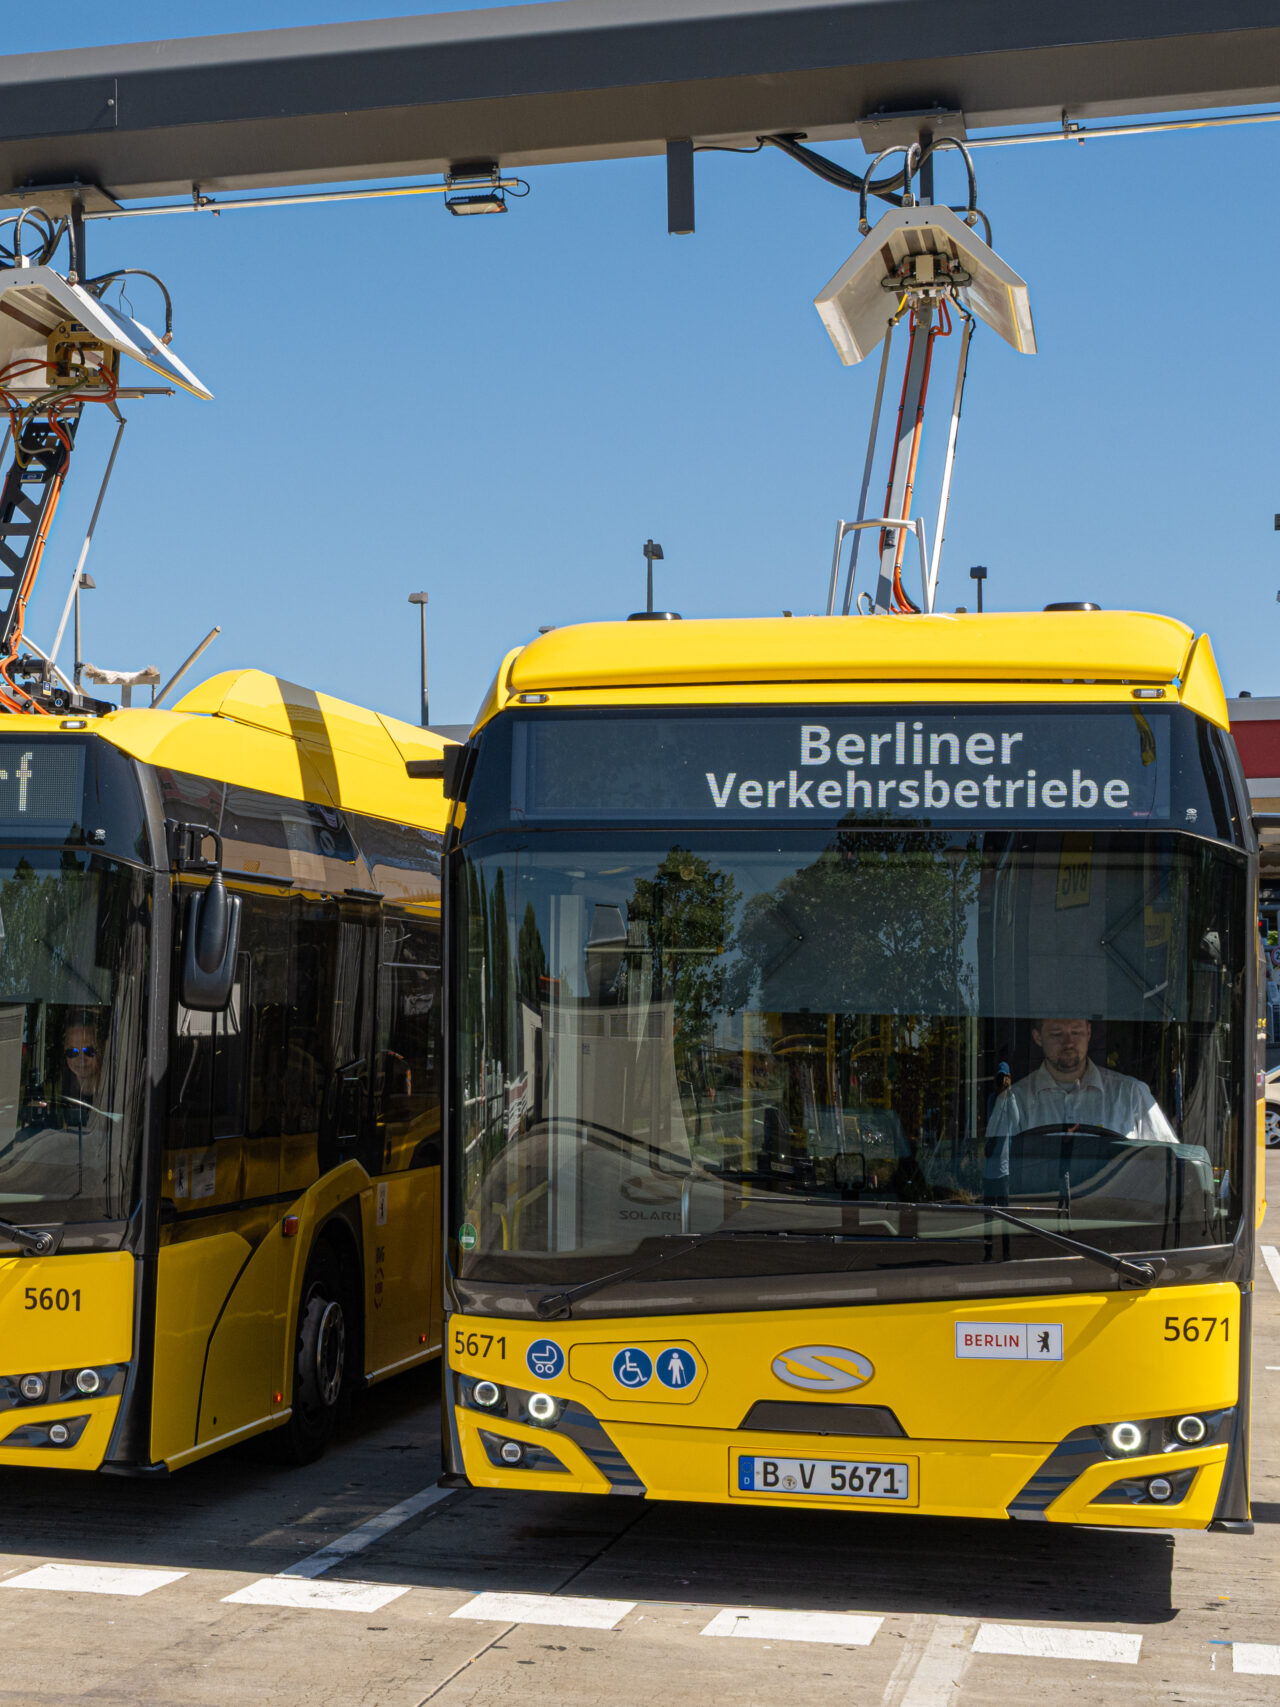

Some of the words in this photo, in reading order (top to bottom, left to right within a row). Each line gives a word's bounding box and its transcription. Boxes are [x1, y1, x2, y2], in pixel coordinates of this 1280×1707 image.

[800, 721, 1023, 766] Berliner
[705, 769, 1130, 808] Verkehrsbetriebe
[24, 1287, 81, 1312] 5601
[964, 1333, 1020, 1348] BERLIN
[1163, 1316, 1230, 1342] 5671
[455, 1331, 506, 1360] 5671
[763, 1461, 780, 1488] B
[799, 1463, 816, 1490] V
[831, 1465, 900, 1495] 5671
